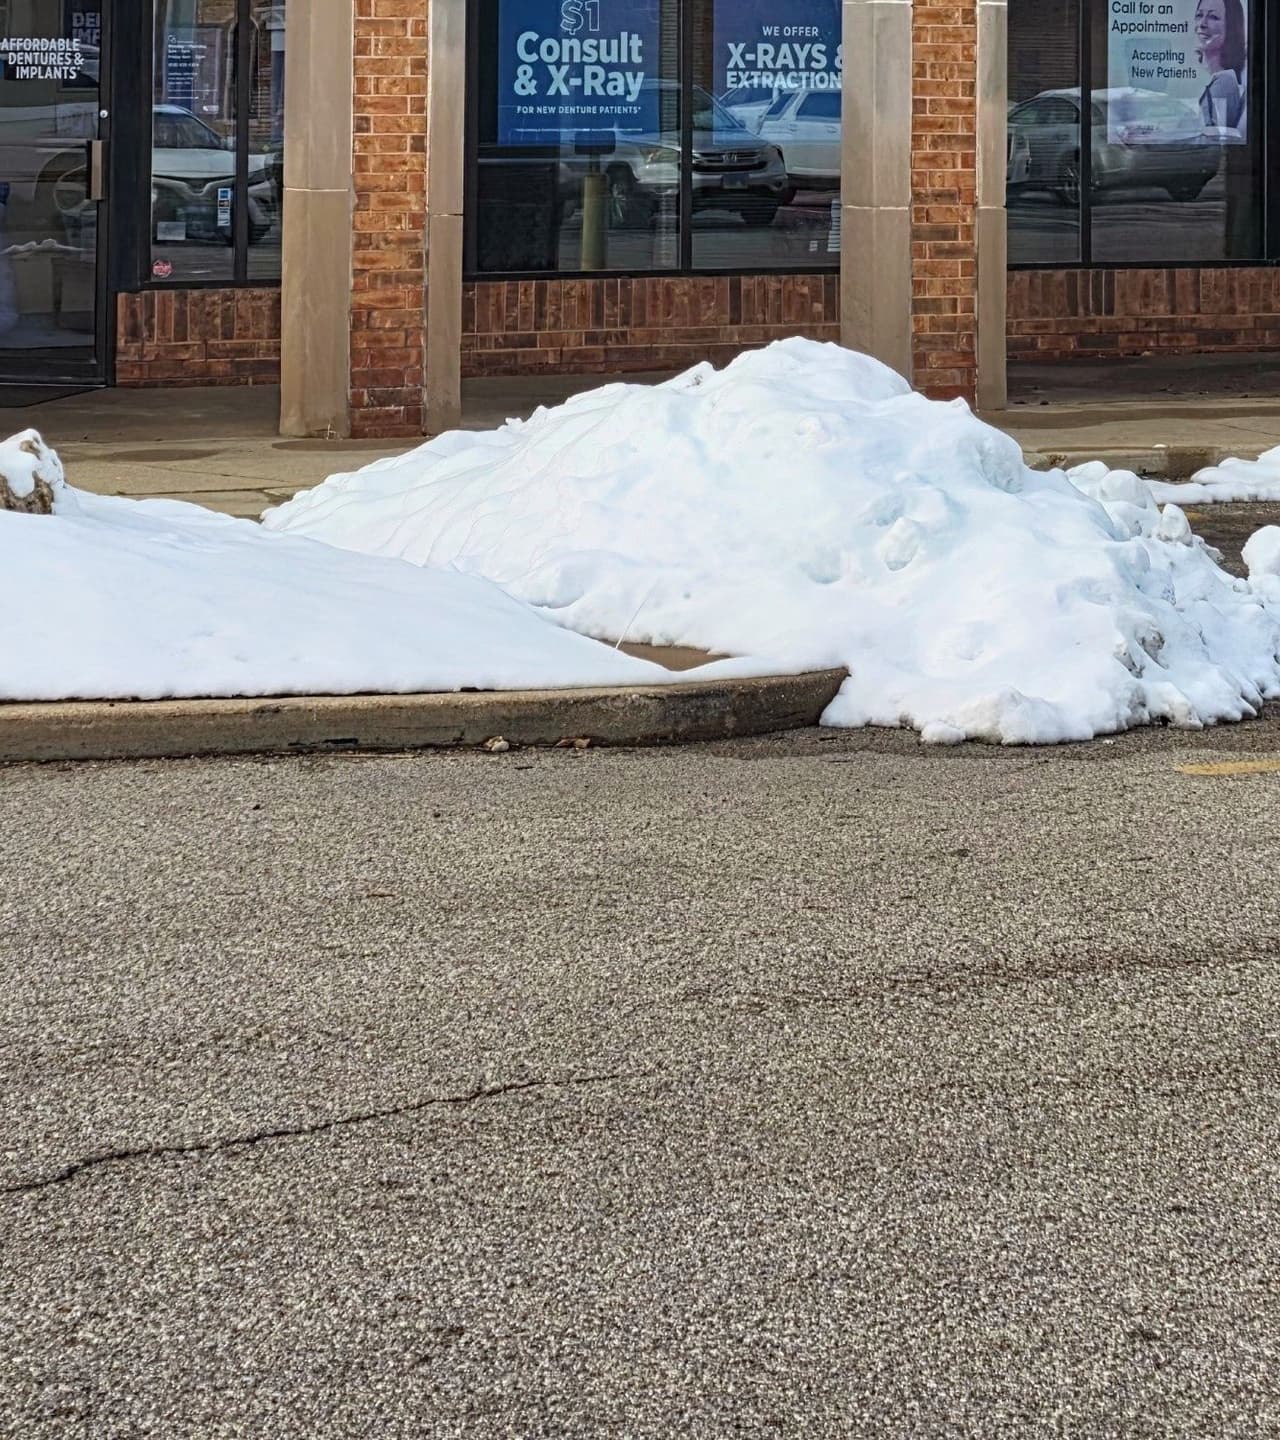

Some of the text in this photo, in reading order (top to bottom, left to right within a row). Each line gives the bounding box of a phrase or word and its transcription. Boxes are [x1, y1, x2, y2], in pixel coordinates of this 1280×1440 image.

[1111, 1, 1173, 15] Call for an
[762, 26, 819, 37] WE OFFER
[1111, 20, 1188, 35] Appointment
[1, 38, 81, 51] AFFORDABLE
[516, 31, 643, 63] Consult
[8, 52, 85, 65] DENTURES &
[726, 42, 828, 69] X-RAYS
[1132, 49, 1185, 64] Accepting
[1131, 66, 1197, 79] New Patients
[514, 64, 645, 102] & X-Ray
[516, 106, 534, 114] FOR
[537, 106, 556, 114] NEW
[558, 106, 596, 114] DENTURE
